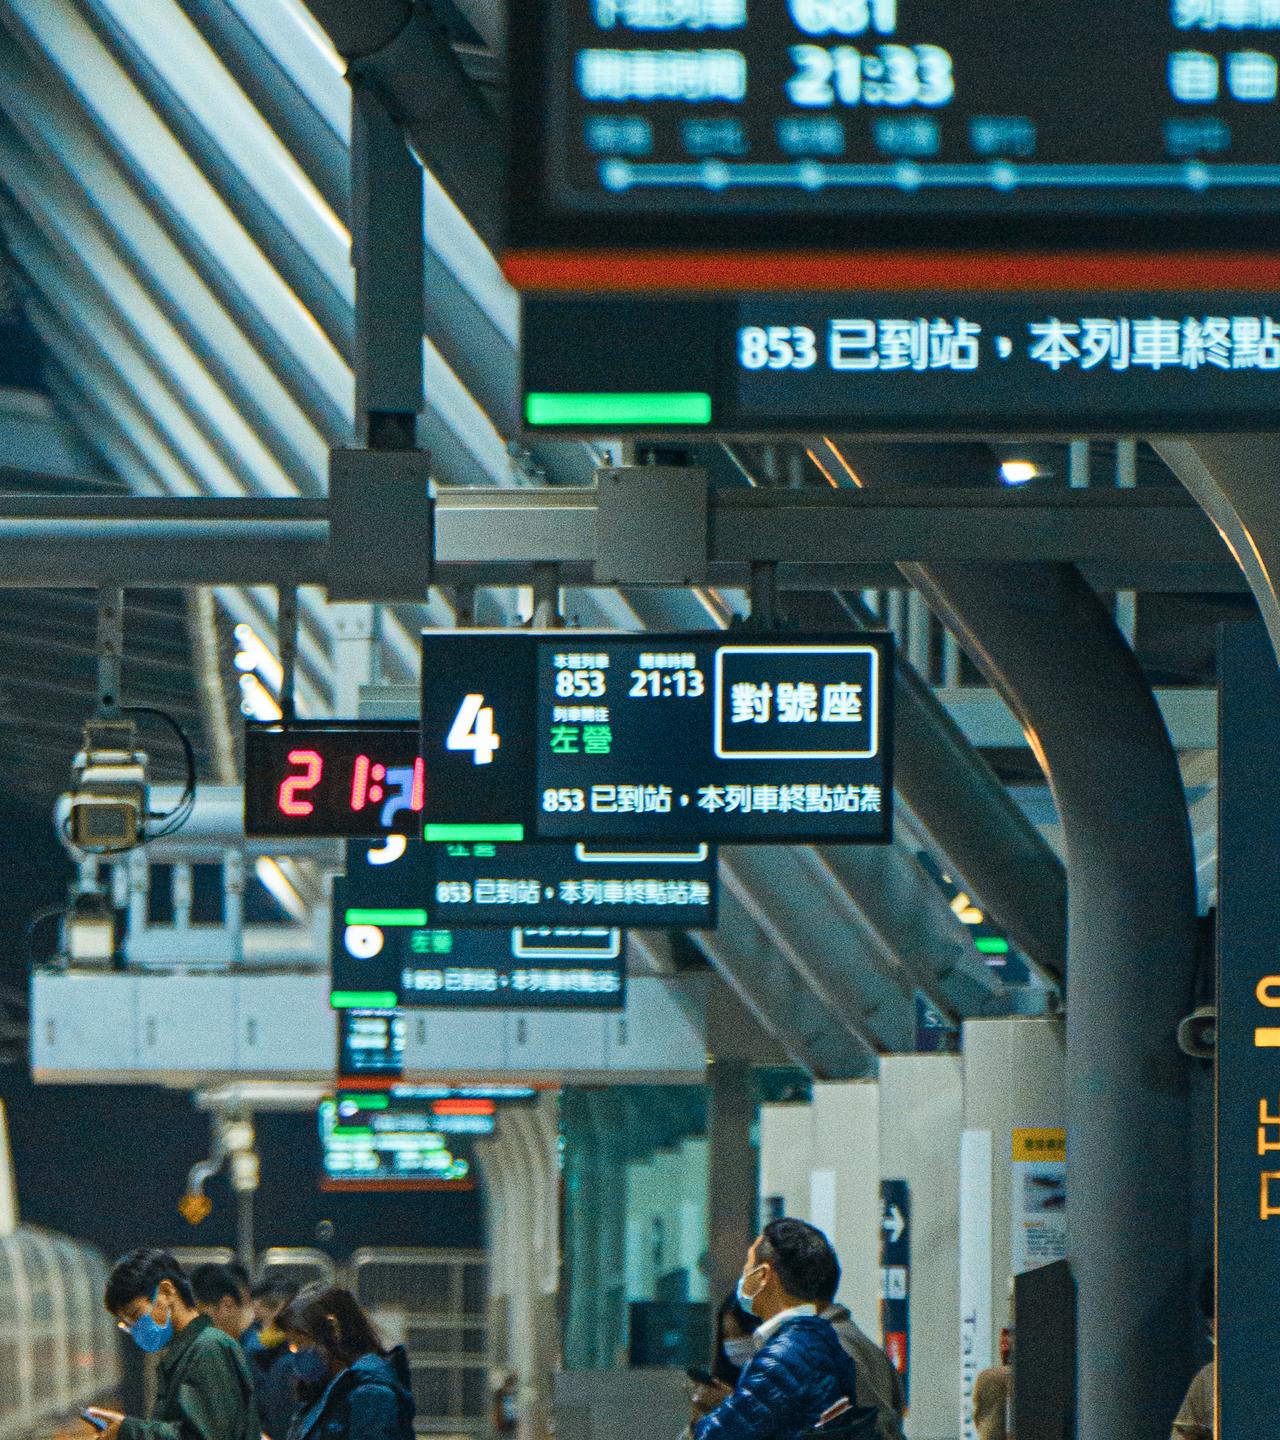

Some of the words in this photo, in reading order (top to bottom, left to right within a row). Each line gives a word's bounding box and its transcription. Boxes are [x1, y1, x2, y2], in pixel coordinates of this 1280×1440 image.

[785, 45, 954, 108] 21:33
[737, 326, 817, 371] 853
[555, 670, 605, 698] 853
[629, 670, 704, 698] 21:13
[730, 682, 862, 723] 對號座
[445, 694, 500, 765] 4
[550, 725, 612, 753] 左營
[541, 789, 584, 812] 853
